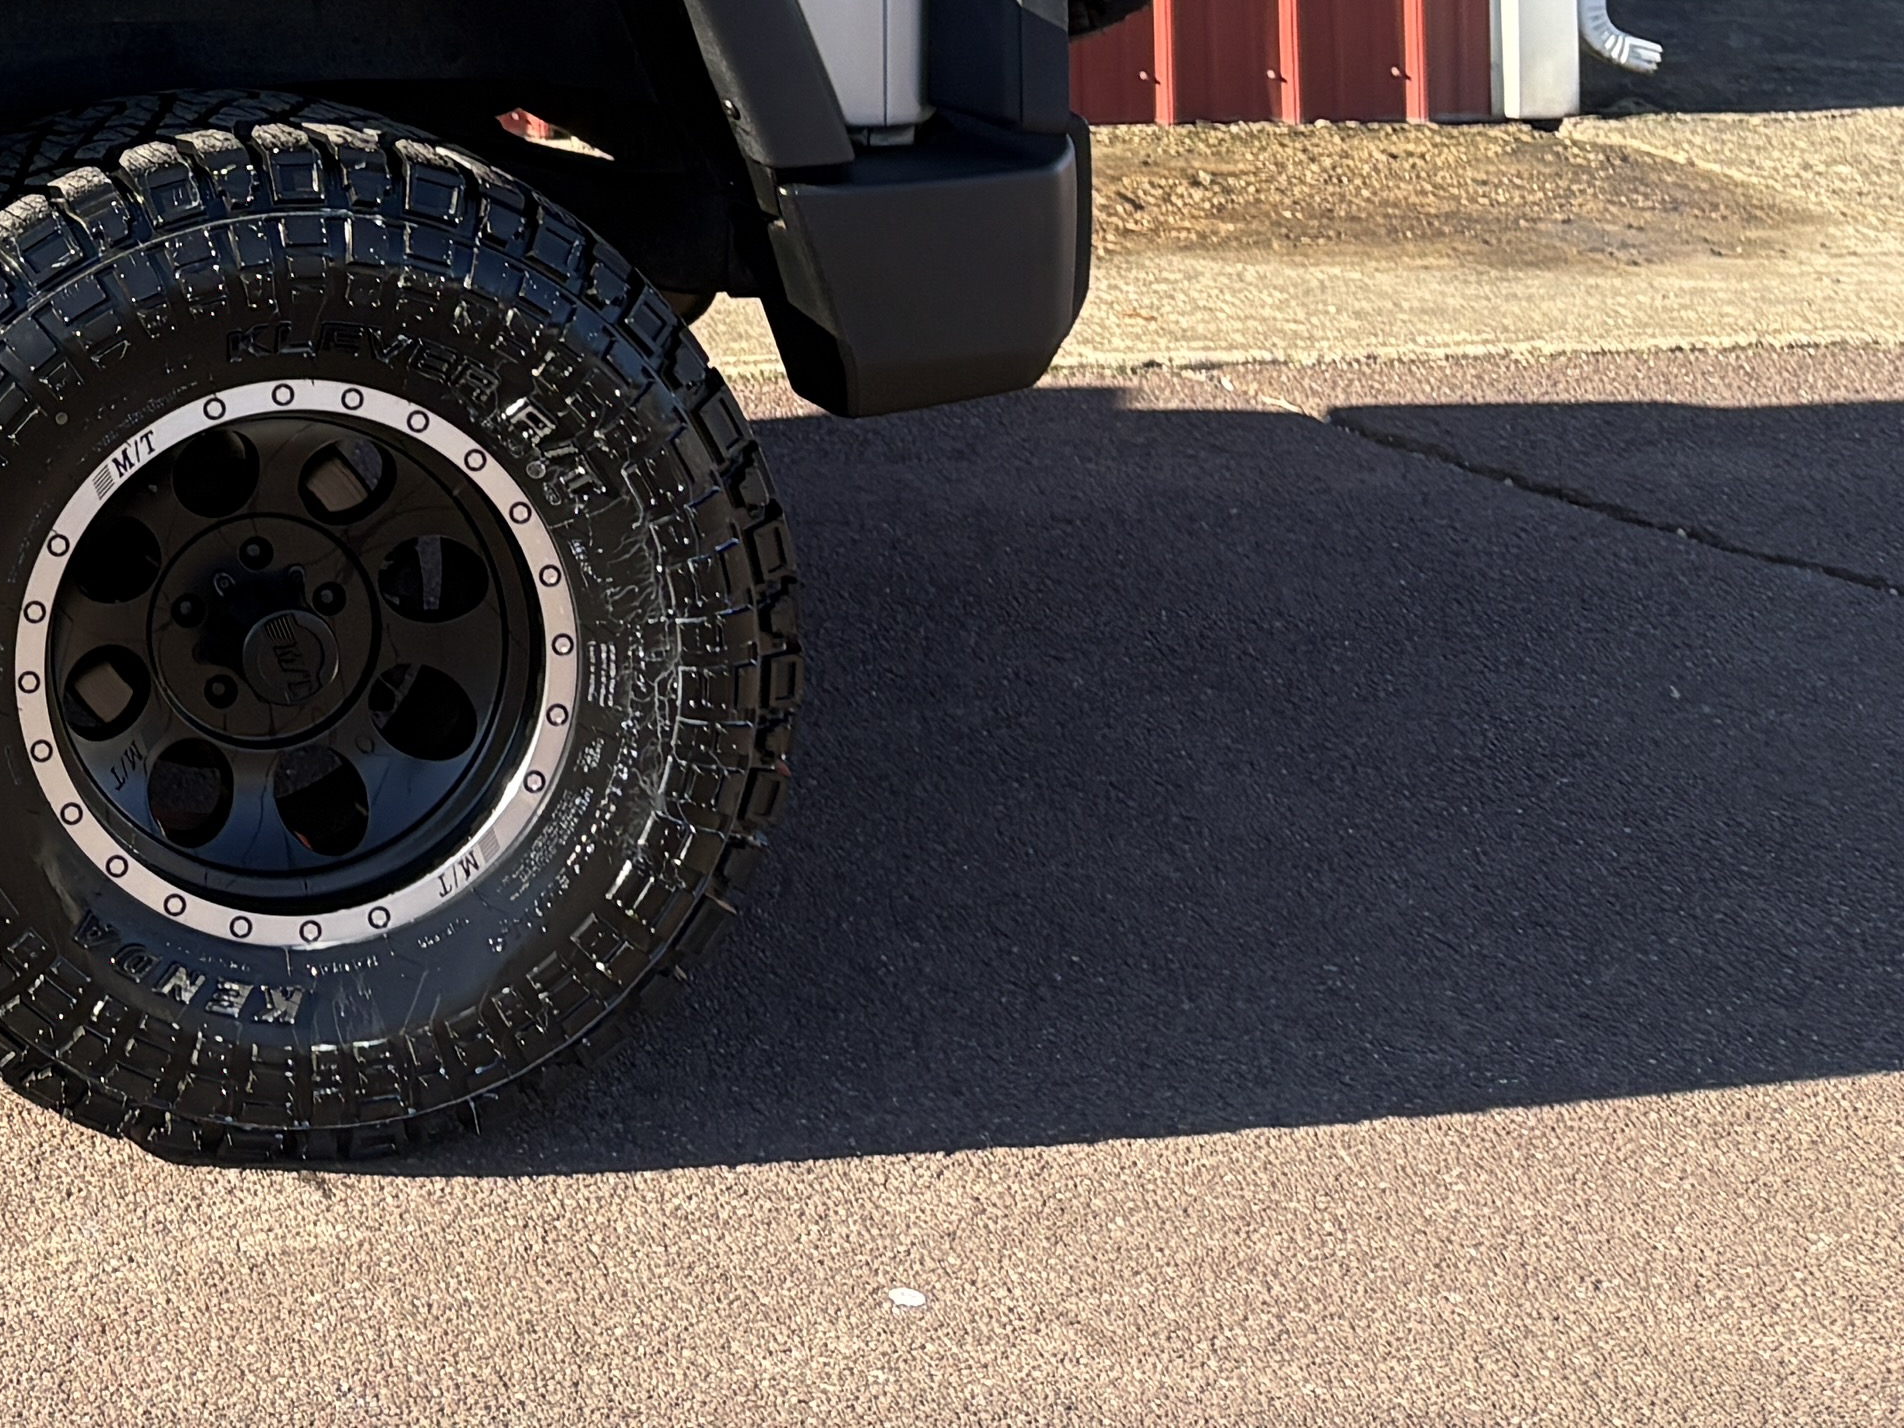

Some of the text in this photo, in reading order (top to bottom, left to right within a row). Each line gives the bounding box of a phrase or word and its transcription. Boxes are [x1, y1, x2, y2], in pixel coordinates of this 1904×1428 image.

[227, 320, 500, 405] KLEVER
[112, 429, 155, 478] M/T
[110, 740, 143, 792] M/T
[438, 850, 480, 898] M/T
[73, 908, 304, 1025] KENDA
